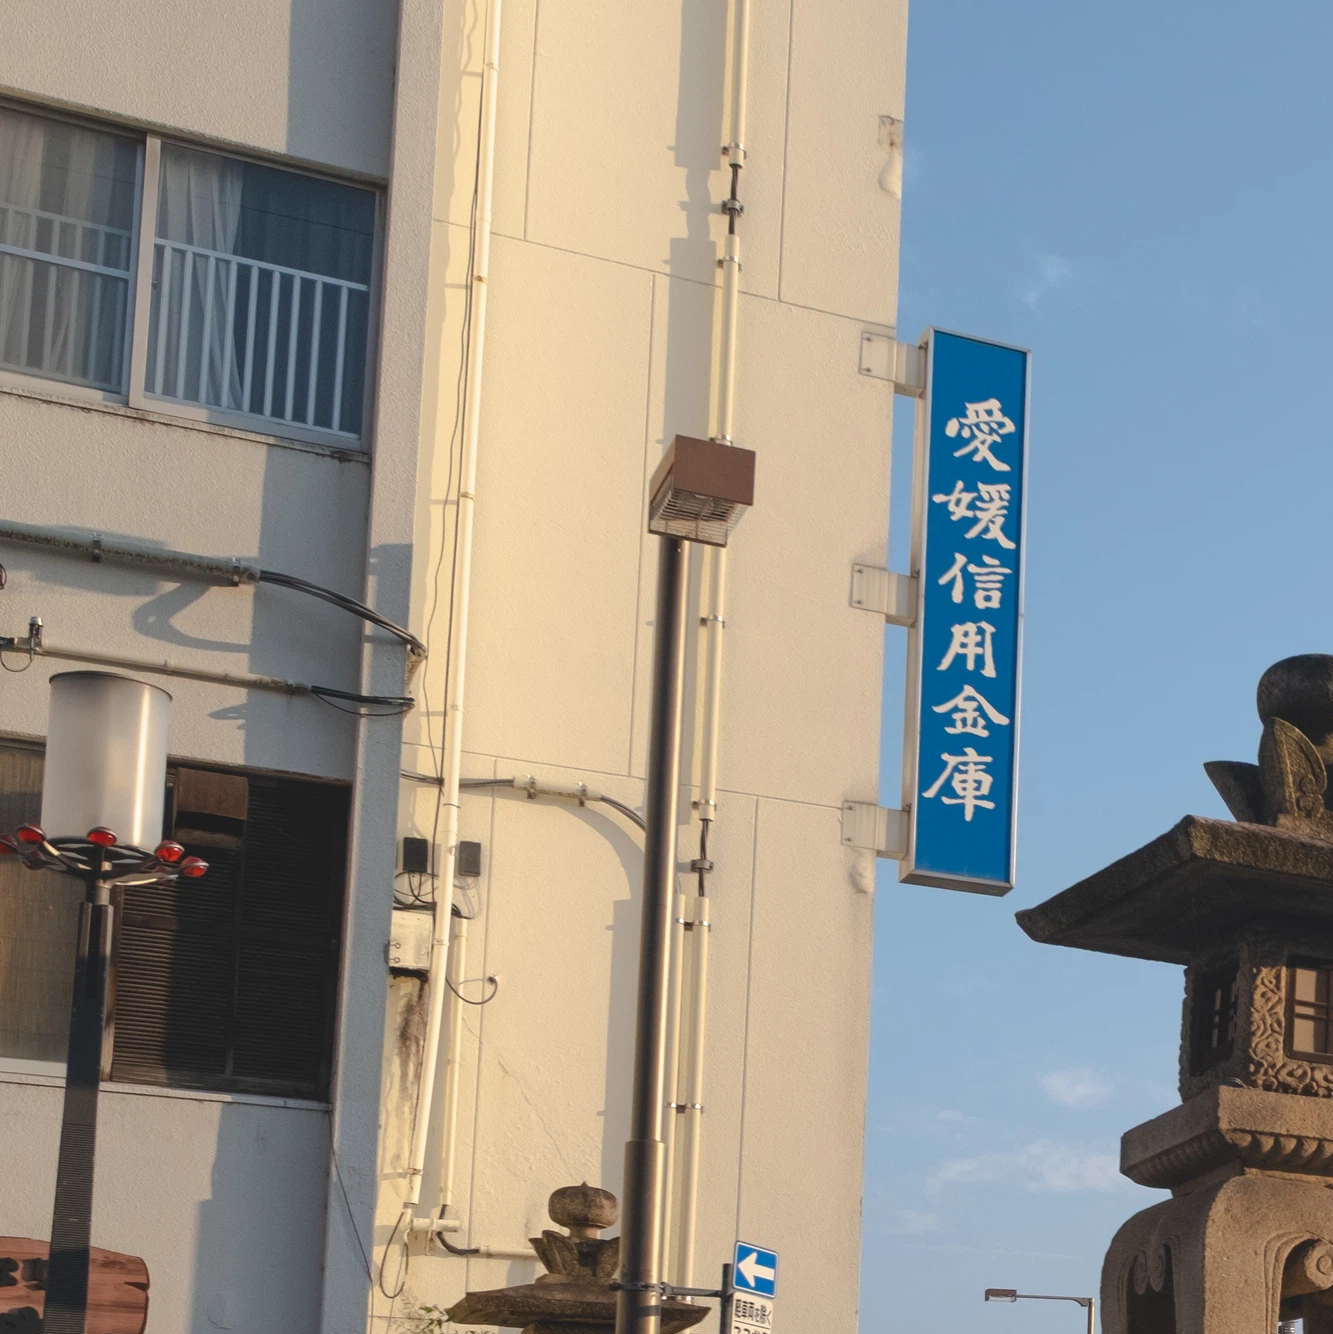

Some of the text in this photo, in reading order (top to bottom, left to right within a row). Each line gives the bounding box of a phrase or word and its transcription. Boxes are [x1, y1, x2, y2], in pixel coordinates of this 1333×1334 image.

[921, 397, 1017, 822] 愛媛信用金庫
